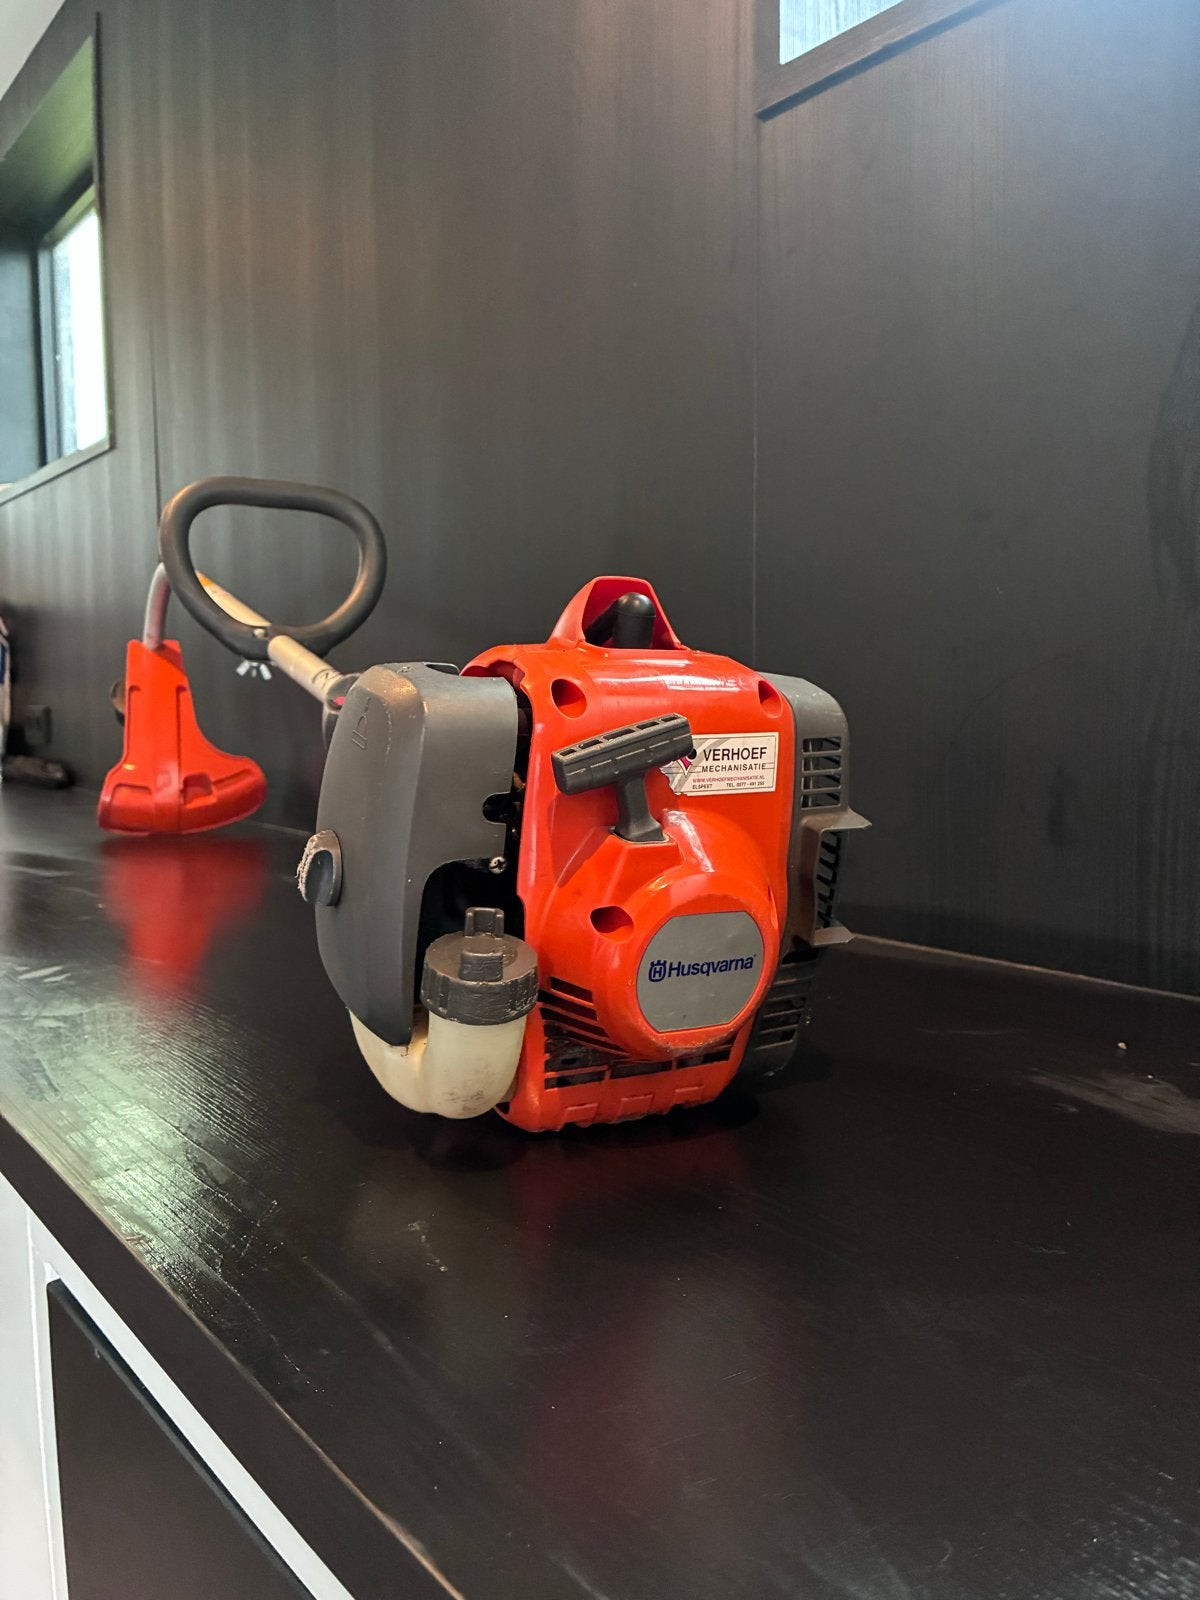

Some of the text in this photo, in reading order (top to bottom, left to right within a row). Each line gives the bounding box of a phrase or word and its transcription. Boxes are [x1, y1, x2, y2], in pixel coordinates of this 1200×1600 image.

[703, 747, 767, 761] VERHOEF
[701, 763, 766, 773] MECHANISATIE
[692, 775, 765, 783] WWW.VERHOEFMECHANISATIE.NL
[668, 956, 754, 977] Husqvarna
